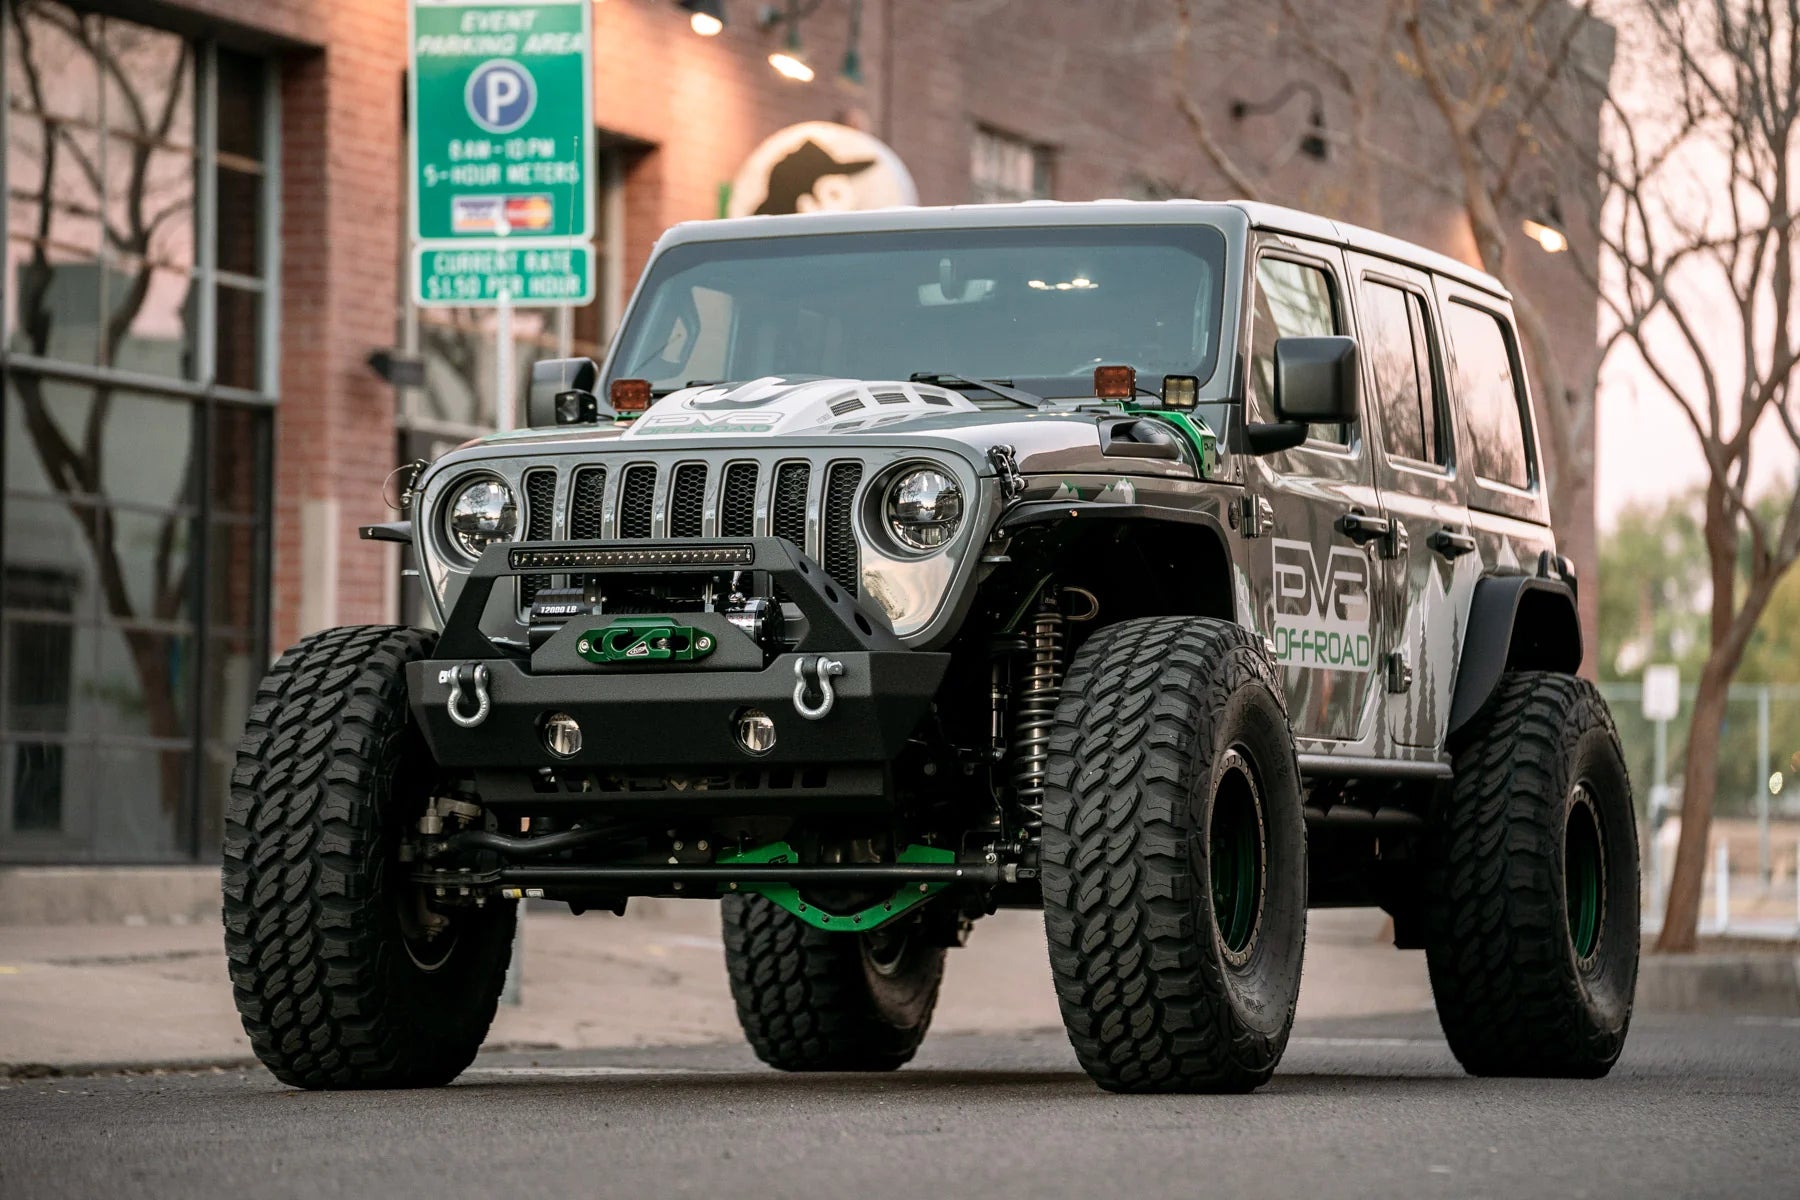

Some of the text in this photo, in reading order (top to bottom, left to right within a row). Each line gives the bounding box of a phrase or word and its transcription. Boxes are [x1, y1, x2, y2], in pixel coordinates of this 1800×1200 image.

[461, 10, 537, 32] EVENT
[417, 32, 583, 56] PARKING AREA
[506, 162, 579, 184] METERS
[434, 251, 572, 275] CURRENT RATE
[486, 275, 524, 296] PER
[528, 274, 580, 296] HOUR
[541, 605, 577, 614] 12000 LB
[1275, 627, 1371, 667] OFFROAD
